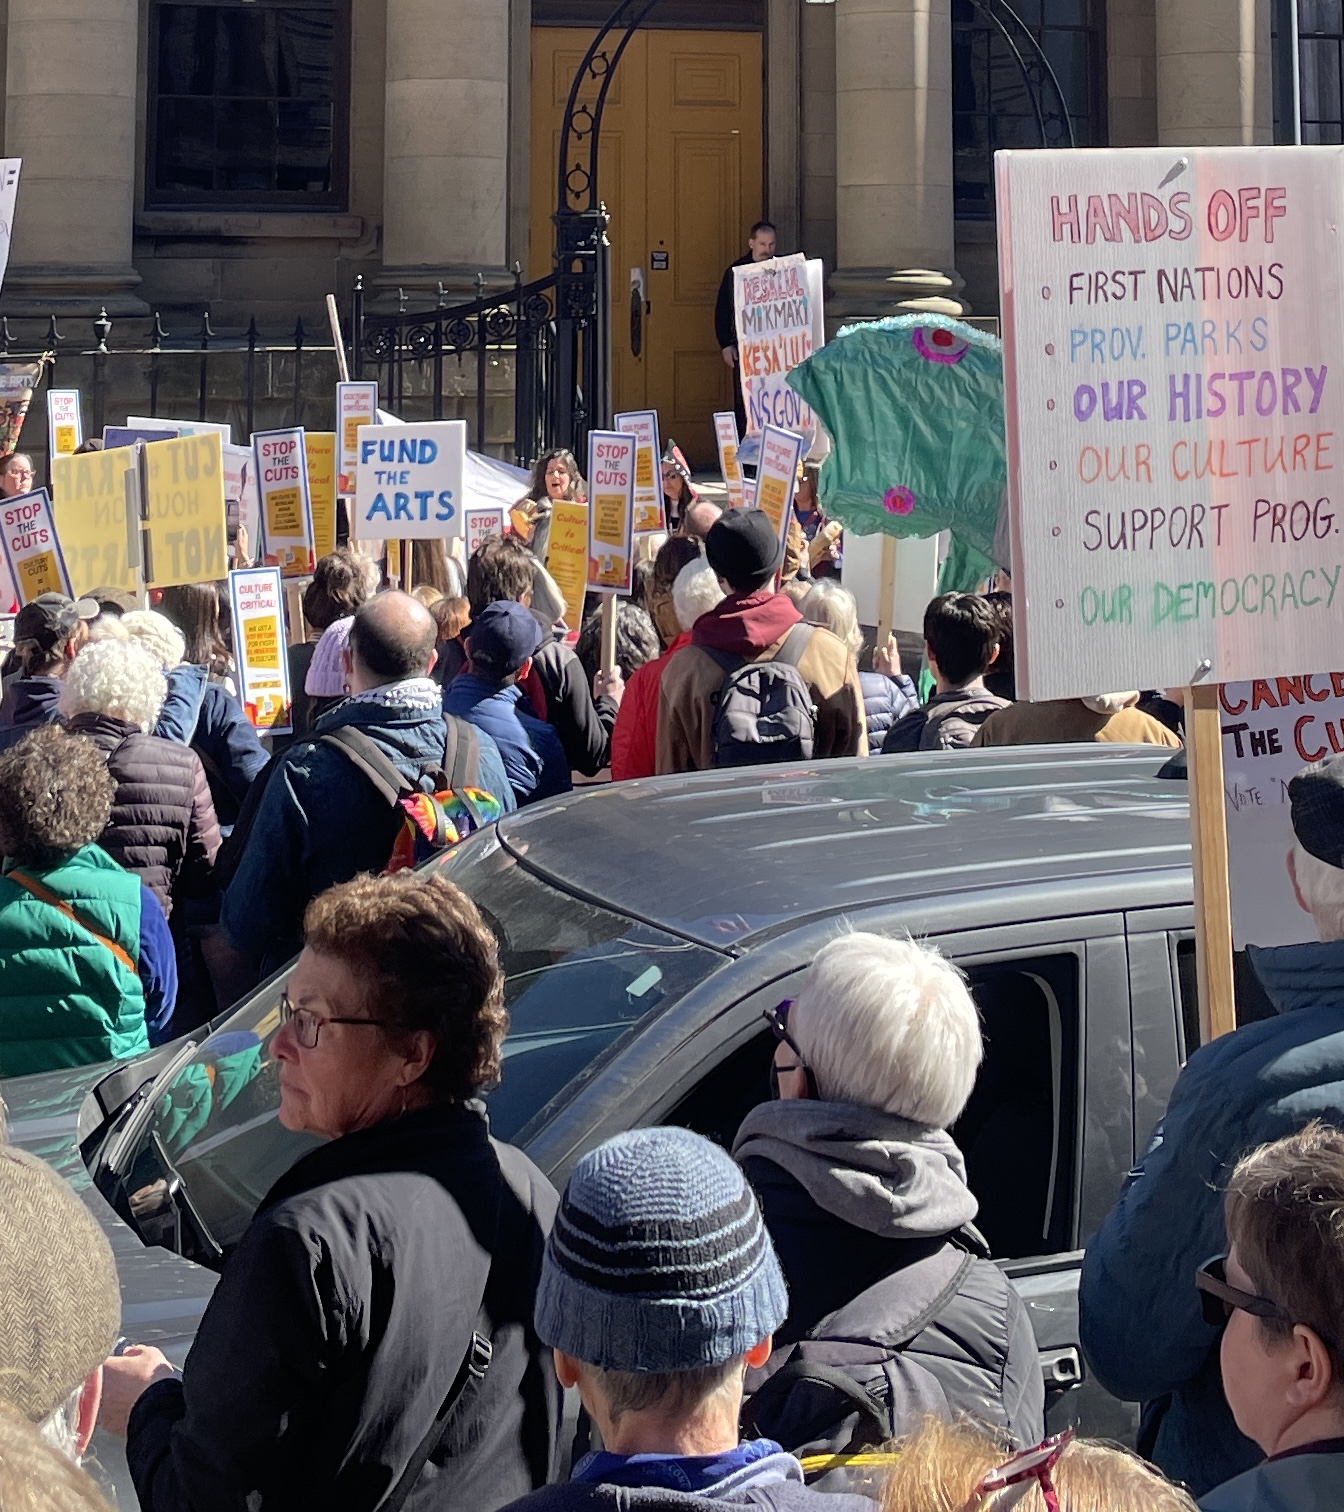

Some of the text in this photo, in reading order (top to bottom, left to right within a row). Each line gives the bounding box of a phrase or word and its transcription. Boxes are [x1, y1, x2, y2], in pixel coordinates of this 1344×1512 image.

[1051, 187, 1287, 245] HANDS OFF
[1068, 262, 1285, 305] FIRST NATIONS
[1070, 316, 1269, 364] PROV. PARKS
[9, 374, 35, 387] ARTS
[54, 397, 74, 406] STOP
[1073, 364, 1328, 423] OUR HISTORY
[55, 412, 75, 421] CUTS
[262, 441, 297, 457] STOP
[361, 439, 438, 465] FUND
[596, 444, 629, 459] STOP
[272, 456, 290, 466] THE
[604, 459, 620, 470] THE
[1079, 432, 1335, 484] OUR CULTURE
[265, 466, 299, 482] CUTS
[375, 470, 411, 486] THE
[595, 470, 628, 487] CUTS
[5, 502, 41, 526] STOP
[365, 490, 456, 522] ARTS
[17, 520, 36, 534] THE
[471, 517, 498, 529] STOP
[1083, 503, 1230, 551] SUPPORT
[1253, 497, 1339, 543] PROG.
[12, 529, 49, 551] CUTS
[478, 529, 492, 537] THE
[28, 564, 49, 576] CUTS
[239, 583, 274, 595] CULTURE
[1080, 564, 1342, 626] OUR DEMOCRACY
[240, 599, 276, 611] CRITICAL!
[1222, 722, 1283, 758] THE
